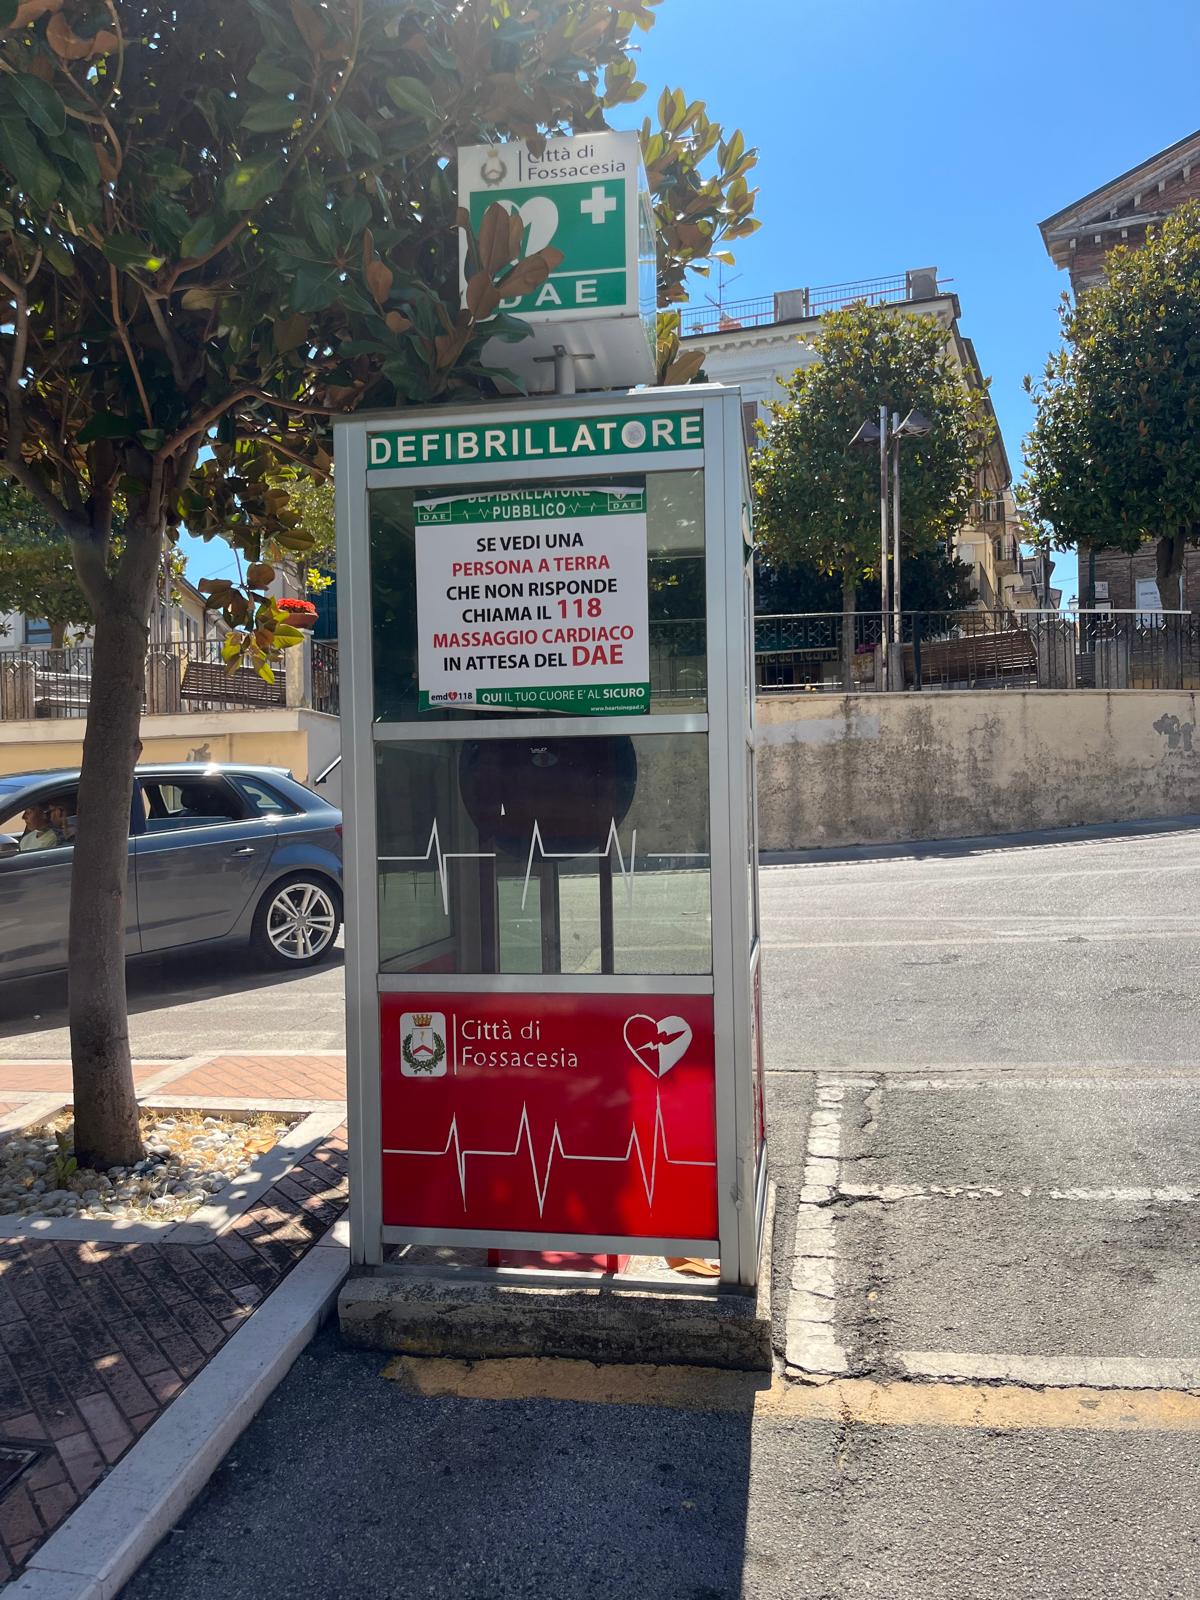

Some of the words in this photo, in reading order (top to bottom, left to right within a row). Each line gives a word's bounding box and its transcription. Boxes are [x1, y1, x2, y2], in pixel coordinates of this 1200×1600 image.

[577, 144, 594, 159] di
[527, 159, 626, 180] Fossacesia
[370, 416, 702, 464] DEFIBRILLATORE
[423, 513, 447, 521] DAE
[492, 502, 566, 519] PUBBLICO
[476, 537, 497, 553] SE
[499, 534, 541, 552] VEDI
[545, 532, 585, 549] UNA
[452, 559, 534, 577] PERSONA
[537, 558, 551, 573] A
[553, 555, 610, 572] TERRA
[446, 585, 481, 601] CHE
[484, 582, 524, 599] NON
[528, 578, 618, 597] RISPONDE
[462, 606, 533, 623] CHIAMA
[536, 605, 552, 620] IL
[557, 597, 602, 619] 118
[433, 629, 538, 648] MASSAGGIO
[541, 625, 634, 644] CARDIACO
[443, 657, 461, 671] IN
[465, 653, 531, 671] ATTESA
[534, 652, 568, 668] DEL
[571, 643, 624, 667] DAE
[431, 692, 448, 701] emd
[459, 692, 473, 700] 118
[481, 692, 502, 704] QUI
[504, 692, 513, 702] IL
[514, 691, 537, 702] TUO
[539, 689, 575, 701] CUORE
[587, 689, 601, 699] AL
[602, 687, 646, 699] SICURO
[461, 1019, 512, 1040] Città
[520, 1020, 540, 1040] di
[462, 1046, 578, 1068] Fossacesia
